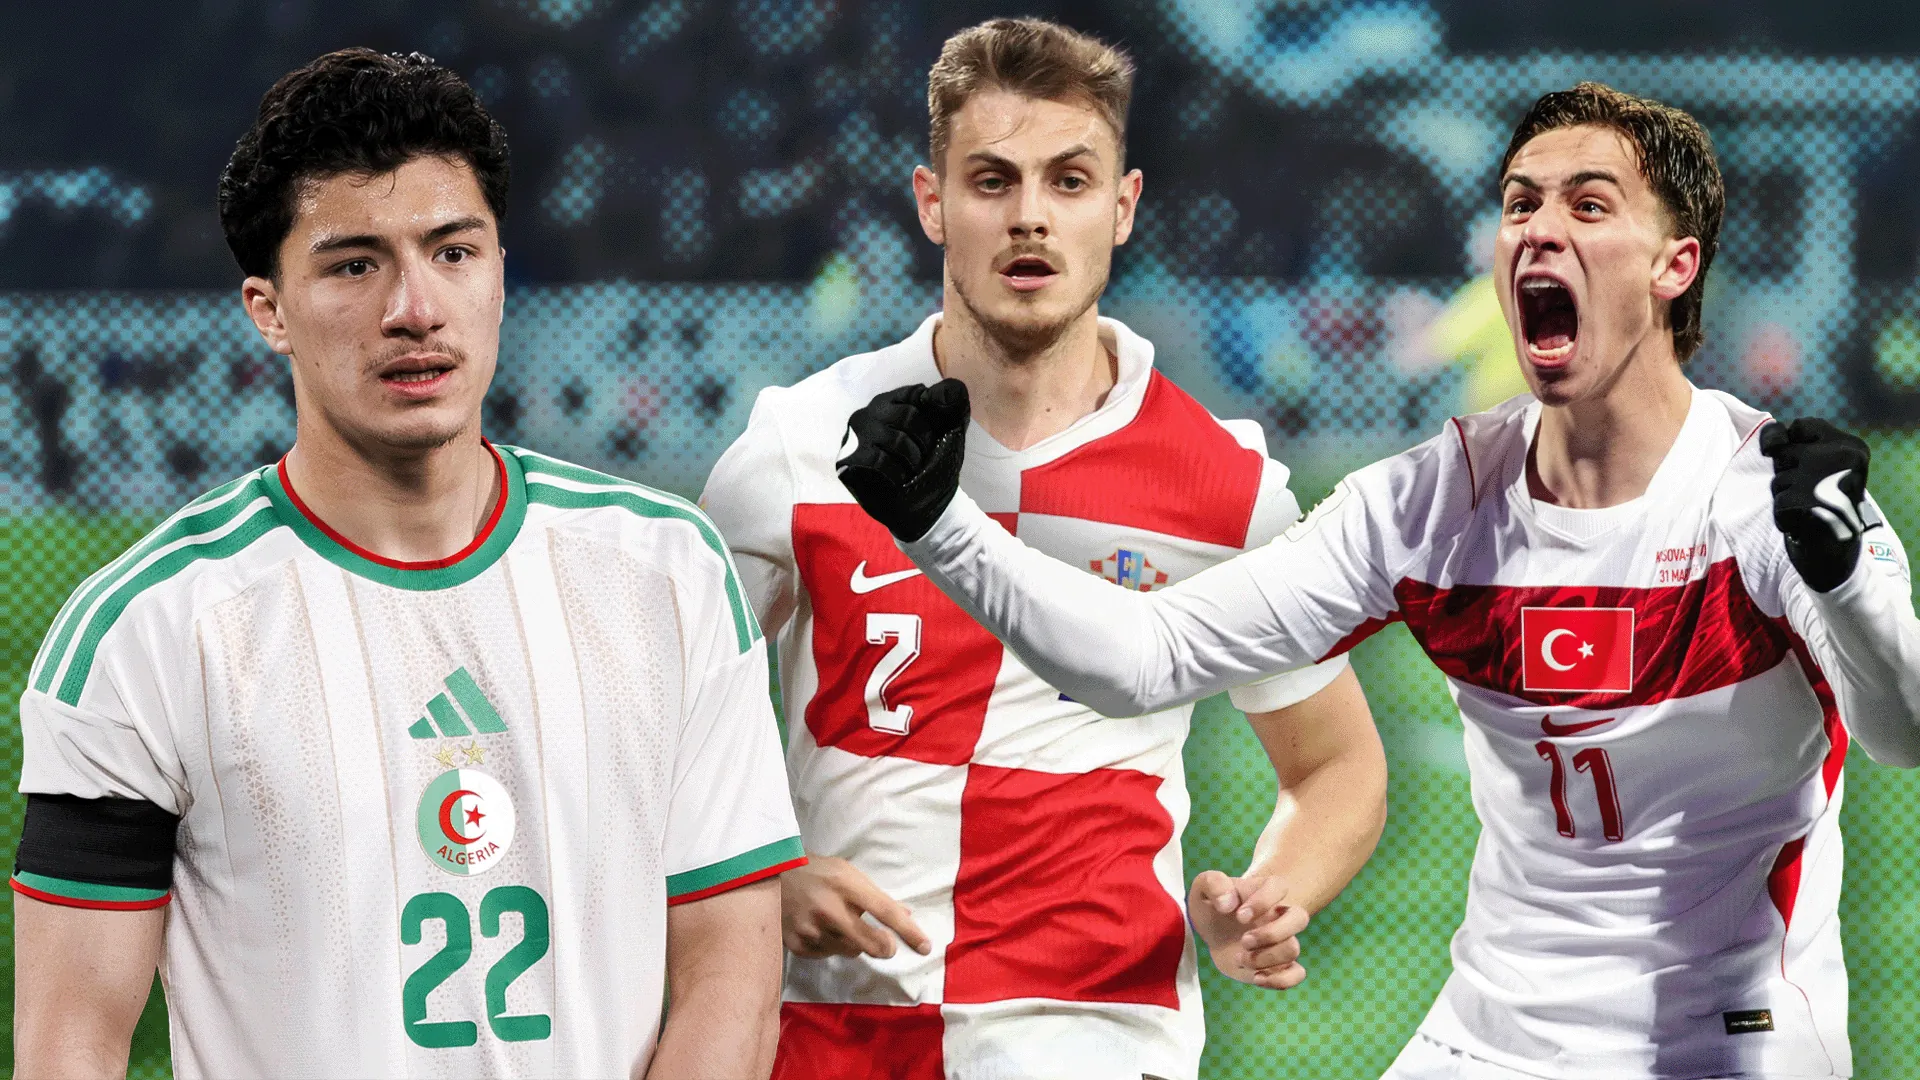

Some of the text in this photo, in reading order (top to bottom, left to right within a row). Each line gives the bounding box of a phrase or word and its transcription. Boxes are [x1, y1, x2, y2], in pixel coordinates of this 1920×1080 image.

[1659, 569, 1669, 583] 31
[864, 612, 921, 736] 2
[1535, 740, 1623, 842] 11
[436, 841, 500, 865] ALGERIA
[401, 885, 551, 1049] 22
